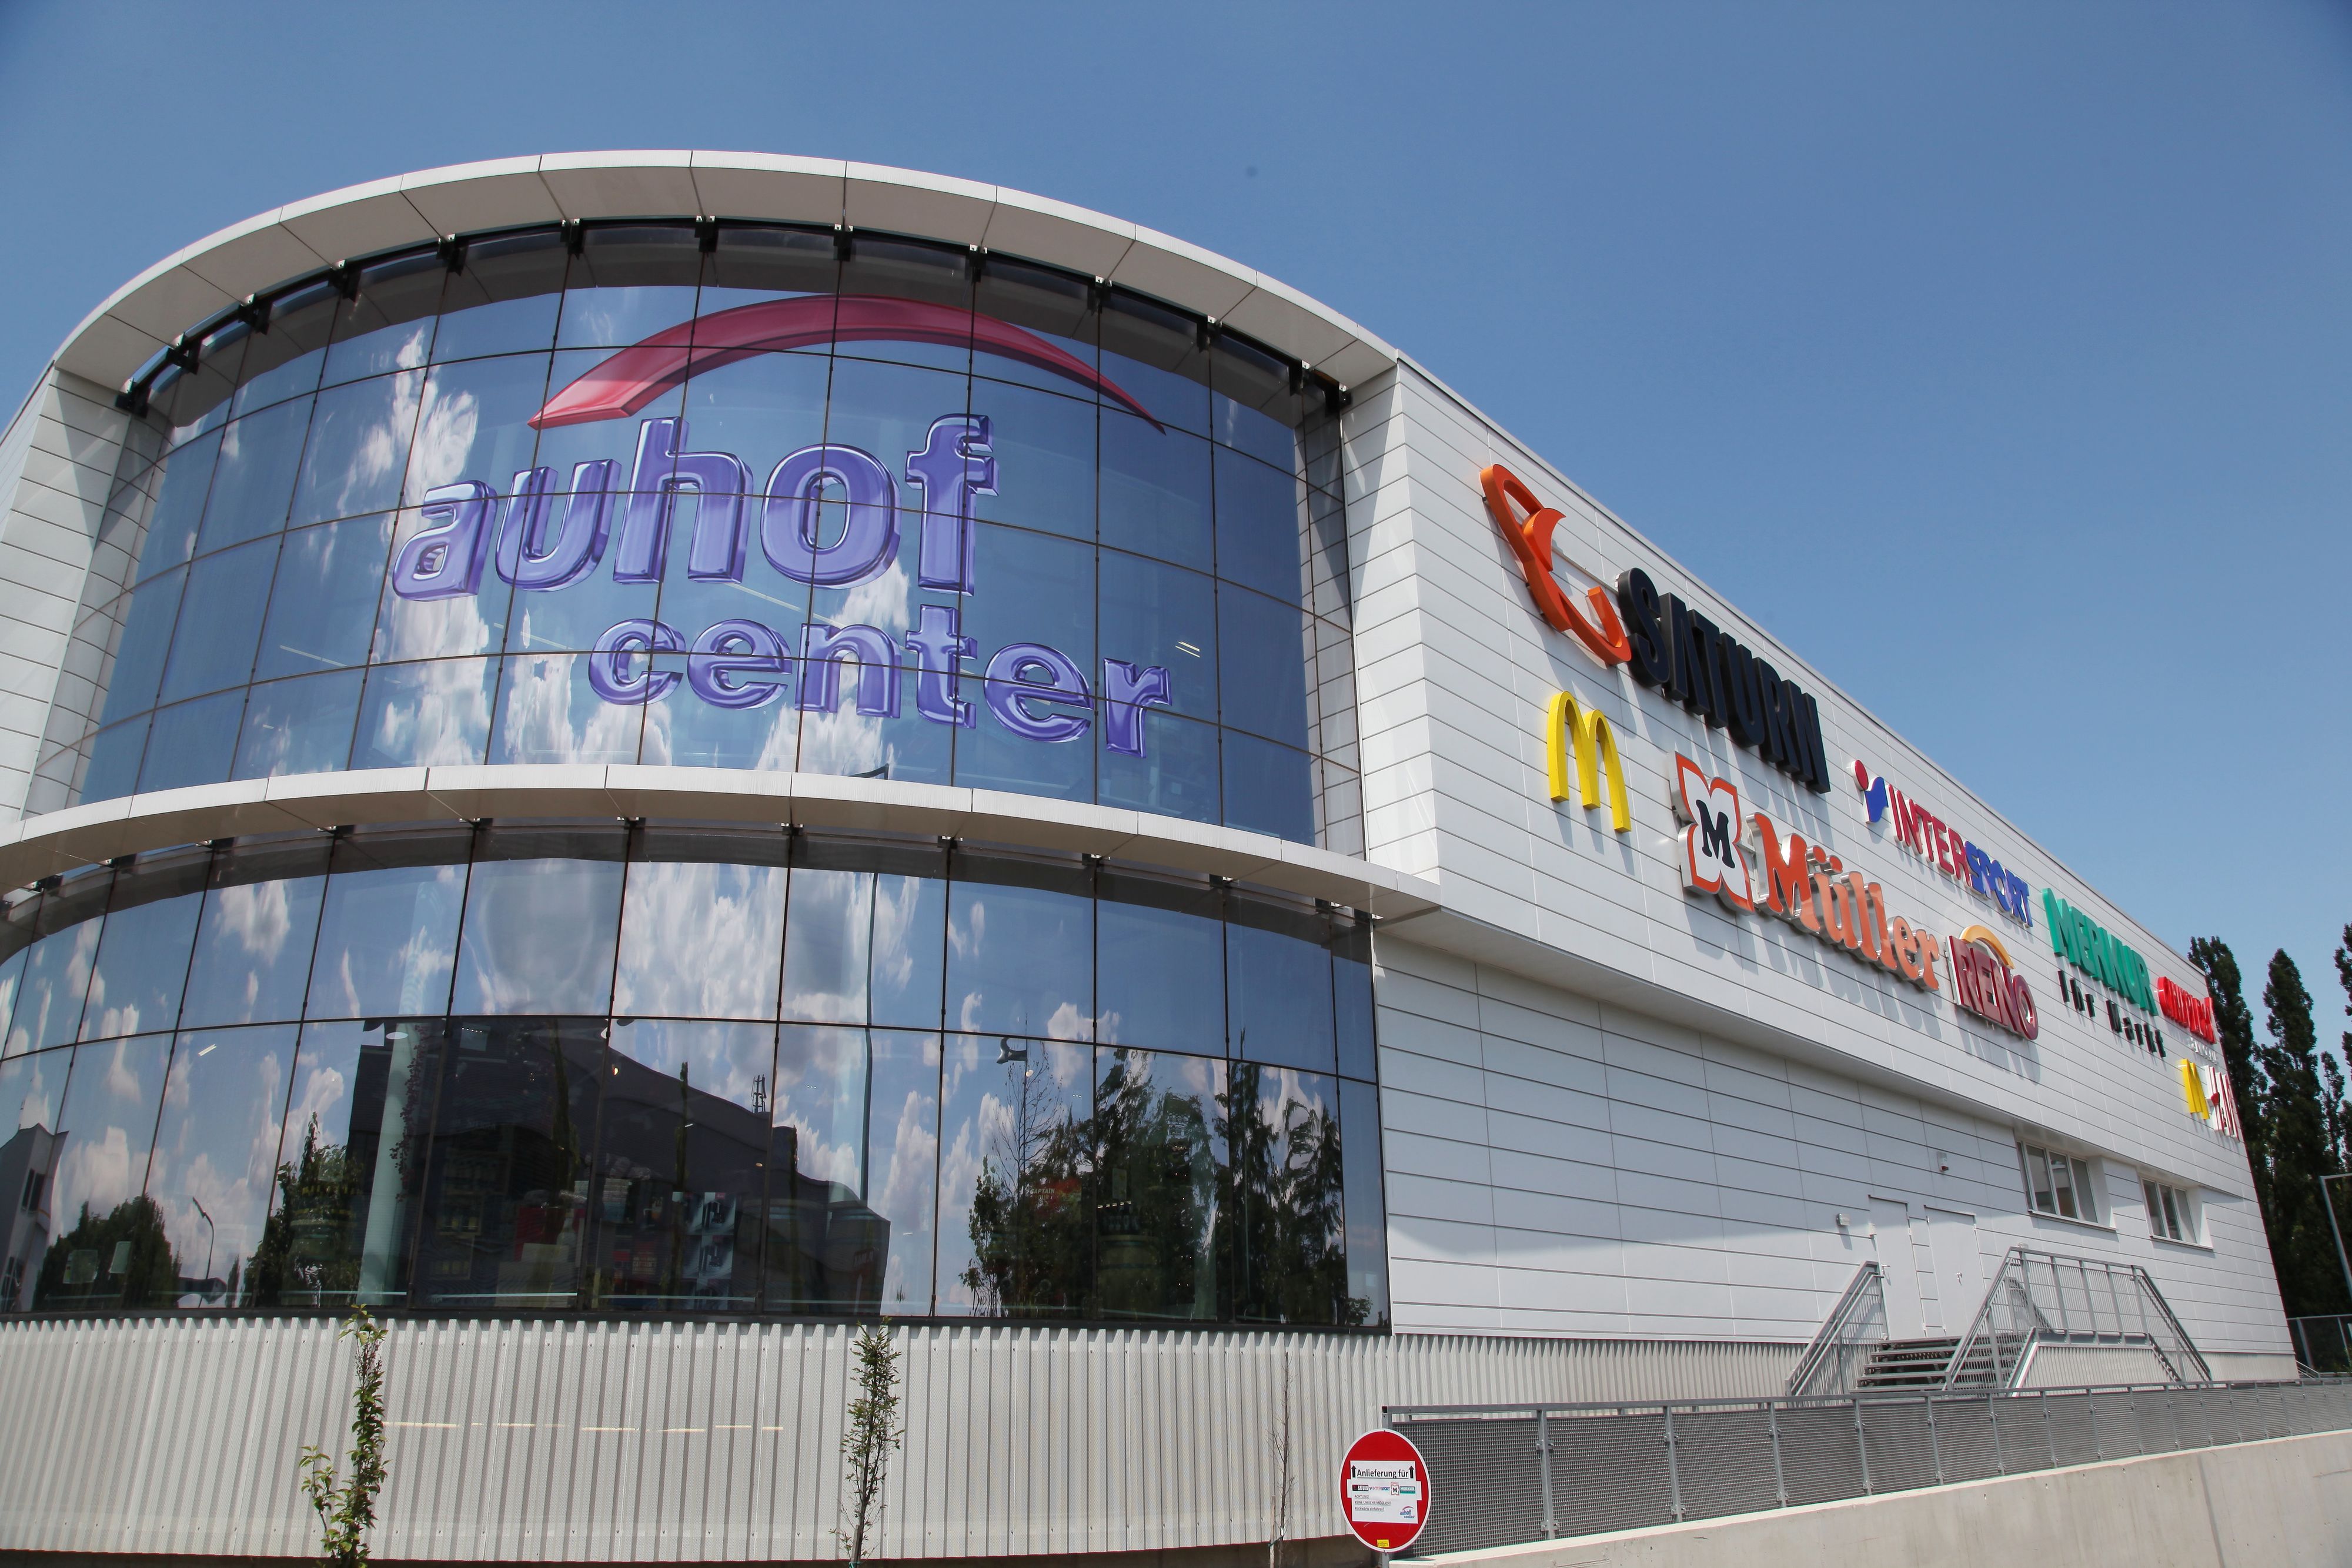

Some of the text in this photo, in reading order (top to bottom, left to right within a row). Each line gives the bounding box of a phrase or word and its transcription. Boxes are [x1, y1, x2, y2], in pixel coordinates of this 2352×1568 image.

[392, 413, 1001, 601] auhof
[588, 604, 1171, 758] center
[1618, 567, 1830, 794] SATURN
[1695, 799, 1735, 869] M
[1746, 811, 1940, 992] Müller
[1886, 784, 2034, 928] INTERSPORT
[1946, 935, 2039, 1041] RENO
[2057, 970, 2096, 1018] Ihr
[2106, 999, 2166, 1058] Markt
[1357, 1469, 1408, 1479] Anlieferung für
